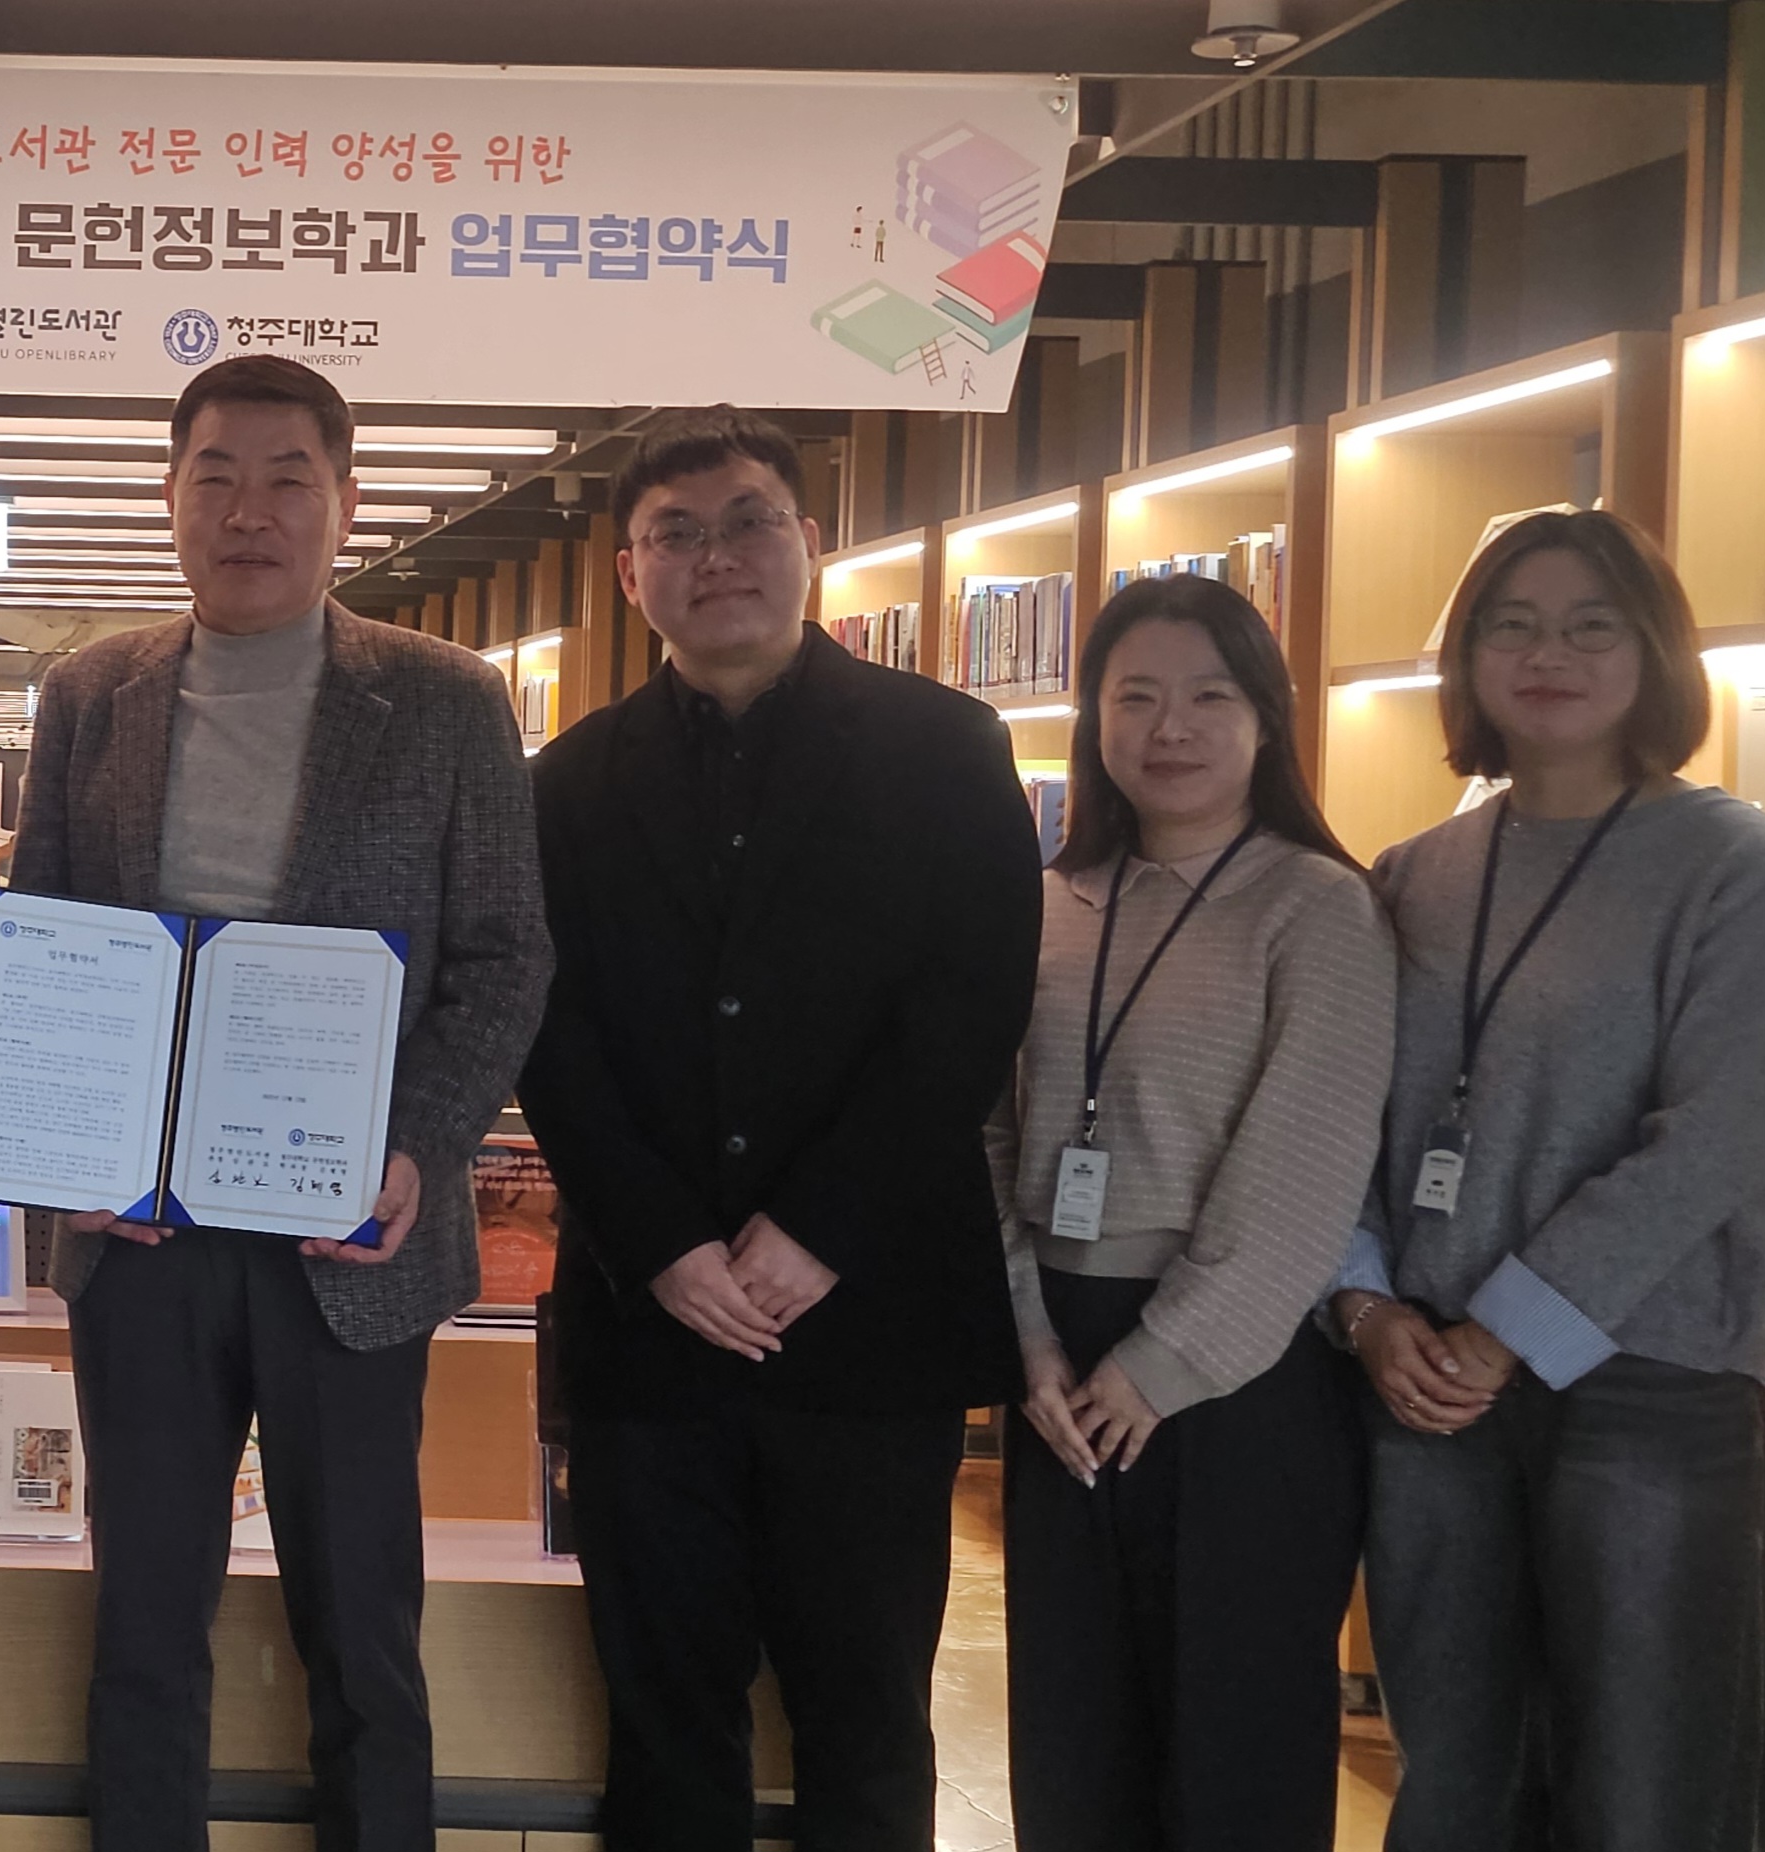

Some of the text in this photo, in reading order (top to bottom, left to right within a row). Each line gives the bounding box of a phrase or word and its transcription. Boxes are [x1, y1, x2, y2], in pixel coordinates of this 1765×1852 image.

[118, 127, 202, 176] 전문
[224, 129, 308, 178] 인력
[331, 132, 462, 183] 양성을
[483, 135, 572, 185] 위한
[13, 203, 427, 274] 문헌정보학과
[451, 213, 789, 284] 업무협약식
[226, 315, 380, 348] 청주대학교
[14, 348, 117, 362] OPENLIBRARY
[295, 354, 363, 367] UNIVERSITY
